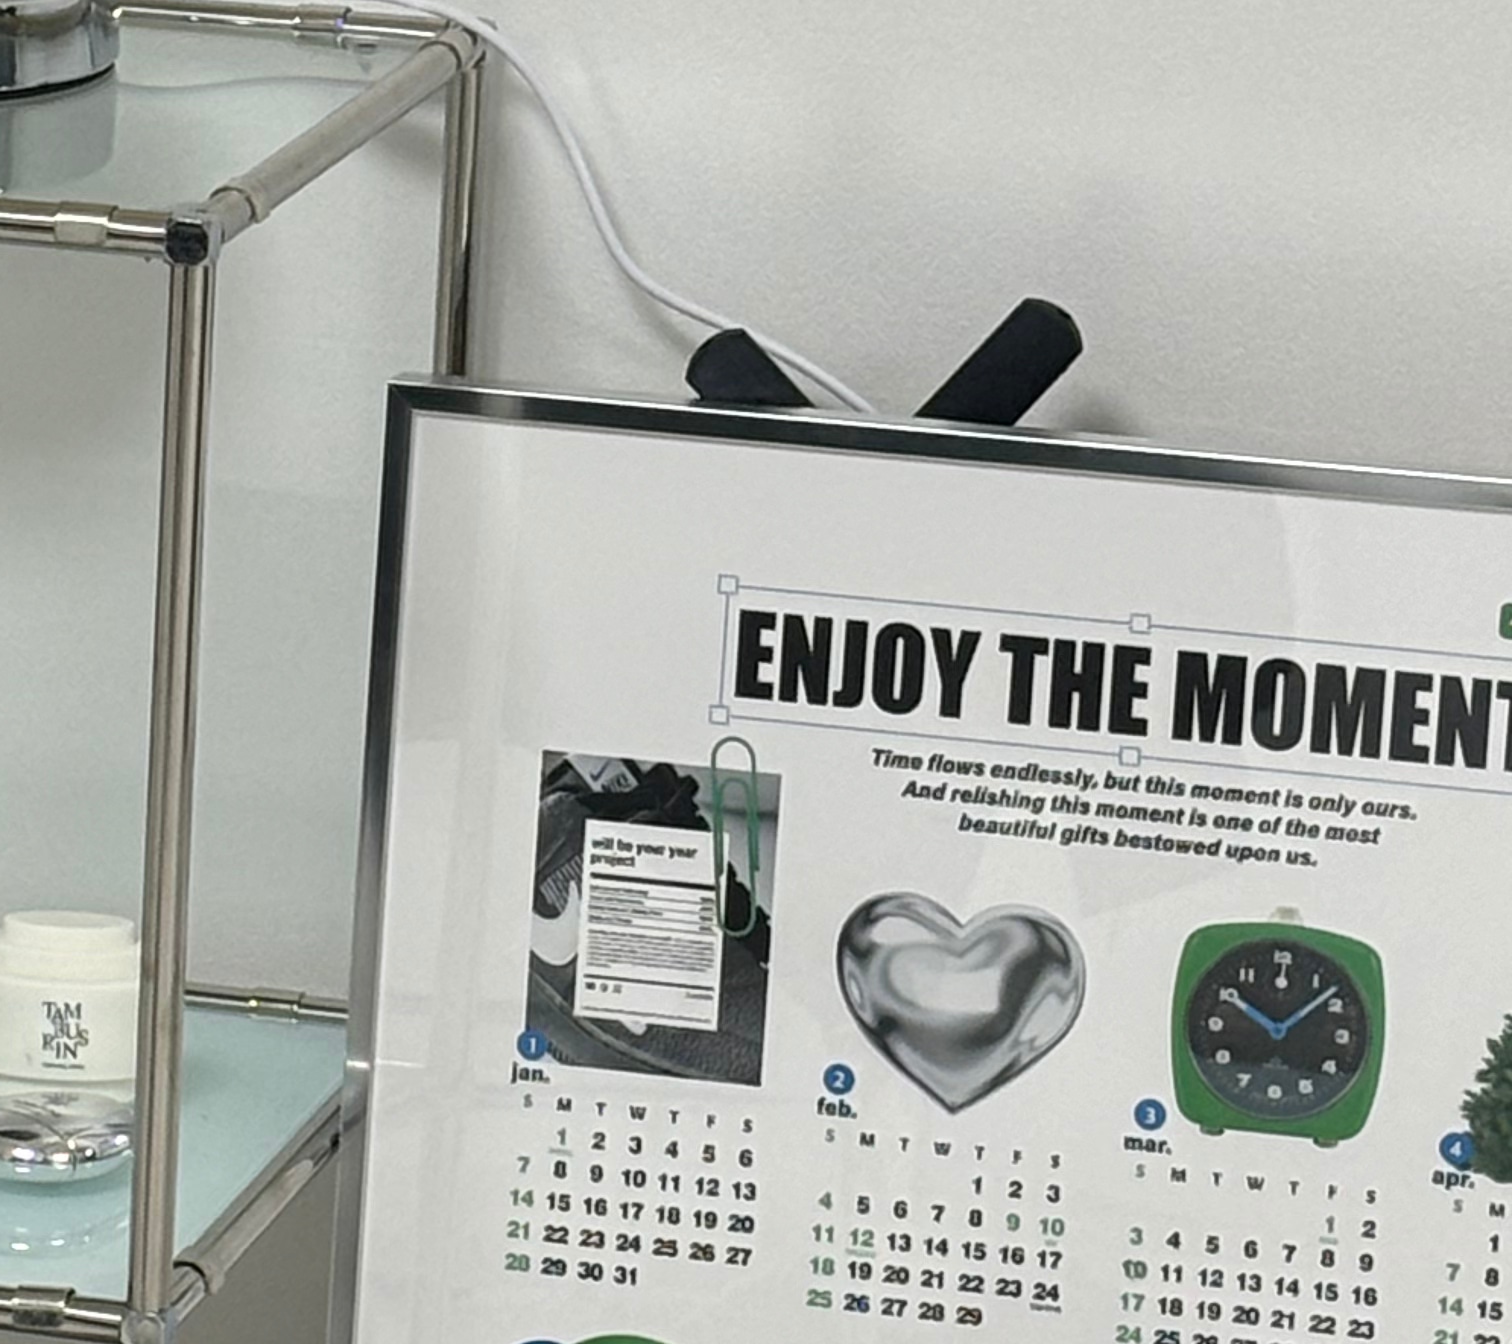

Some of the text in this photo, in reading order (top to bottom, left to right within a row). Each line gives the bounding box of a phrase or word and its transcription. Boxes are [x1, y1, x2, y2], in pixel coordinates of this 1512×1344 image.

[734, 609, 982, 719] ENJOY
[999, 633, 1152, 737] THE
[873, 749, 1417, 820] Time flows endlessly, but this moment is only ours.
[902, 780, 1381, 845] And relishing this moment is one of the most
[958, 813, 1317, 867] beautiful gifts bestowed upon us.
[511, 1061, 550, 1084] jan.
[817, 1096, 858, 1119] feb.
[1124, 1135, 1172, 1155] mar.
[516, 1157, 756, 1201] 7 8 9 10 11 12 13
[1432, 1170, 1475, 1190] apr.
[1161, 1264, 1377, 1306] 11 12 13 14 15 16
[1438, 1296, 1503, 1321] 14 15
